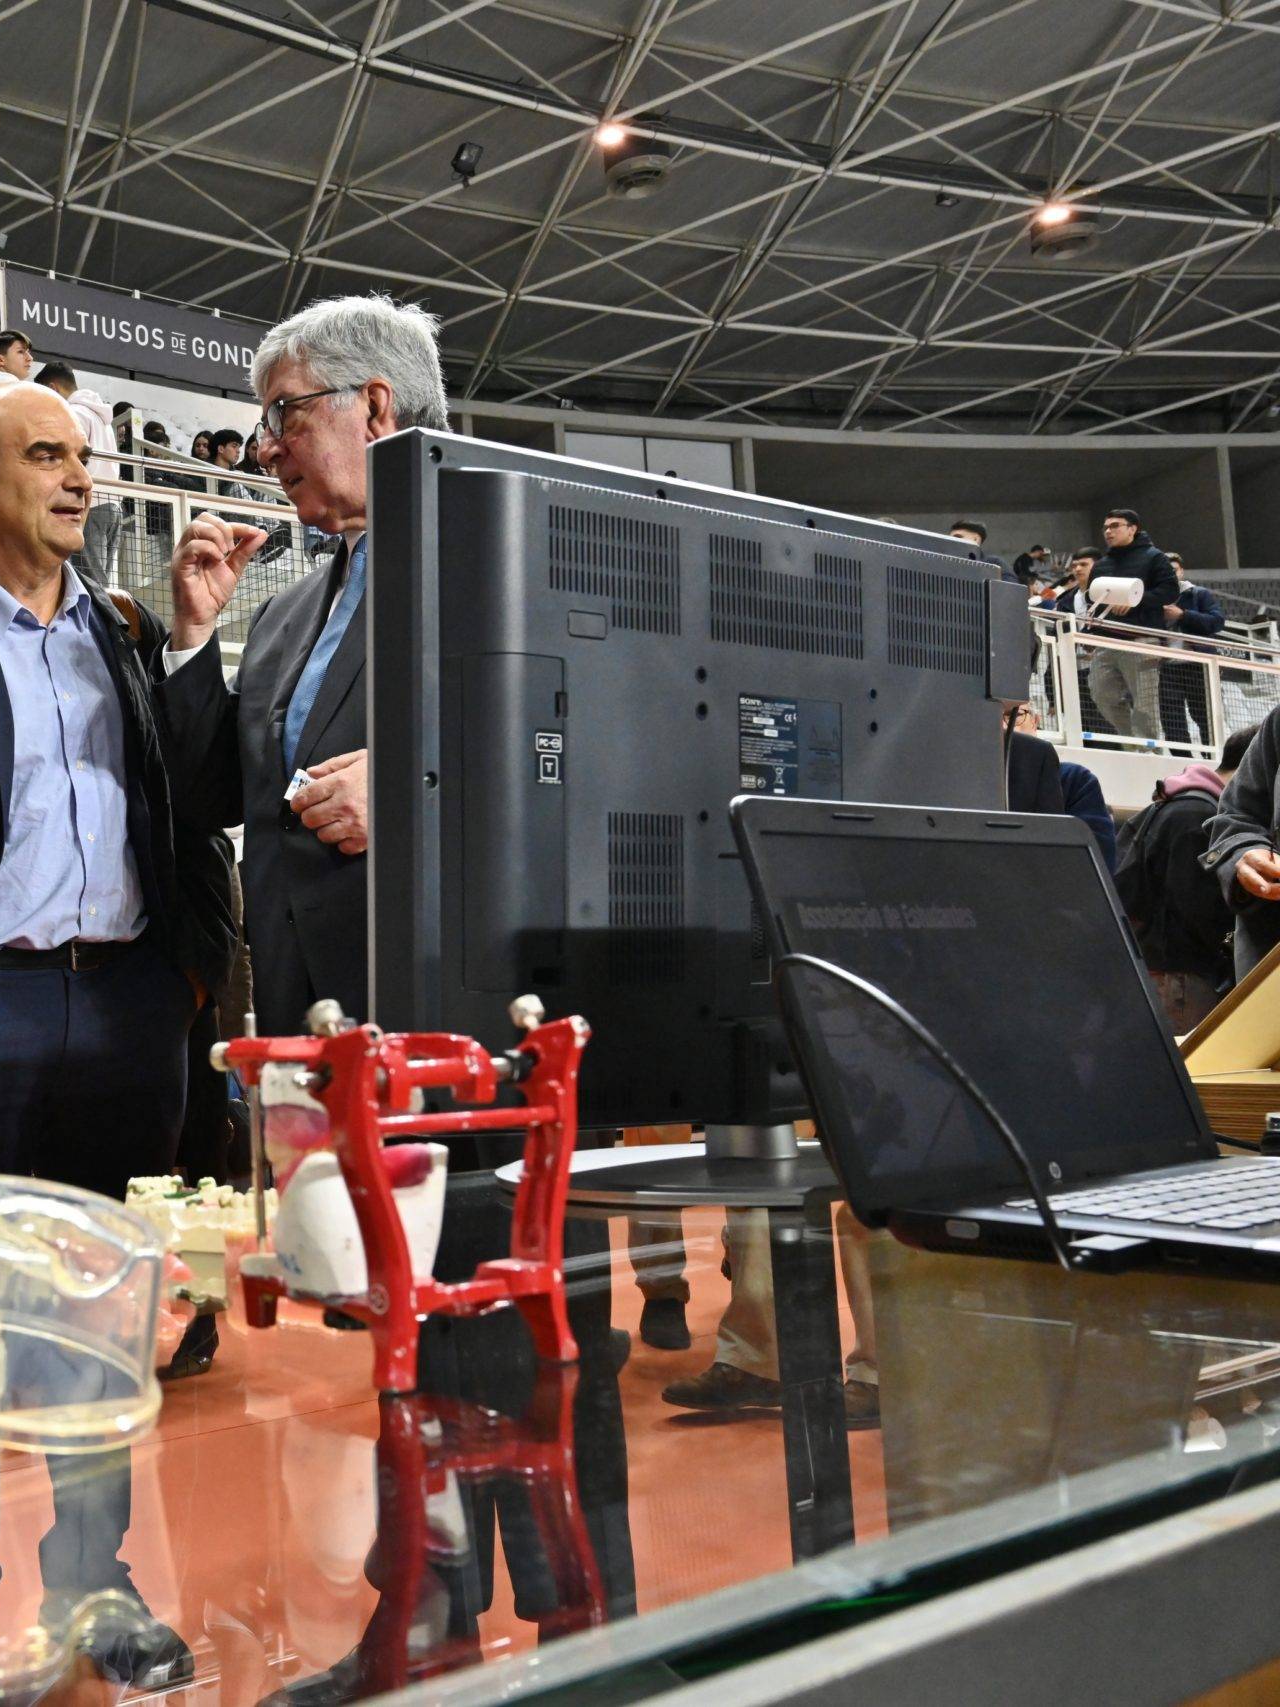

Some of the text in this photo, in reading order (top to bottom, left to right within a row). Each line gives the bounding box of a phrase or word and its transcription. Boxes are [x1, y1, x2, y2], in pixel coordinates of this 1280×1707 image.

[22, 298, 165, 350] MULTIUSOS
[171, 336, 187, 351] DE
[740, 697, 762, 706] SONY
